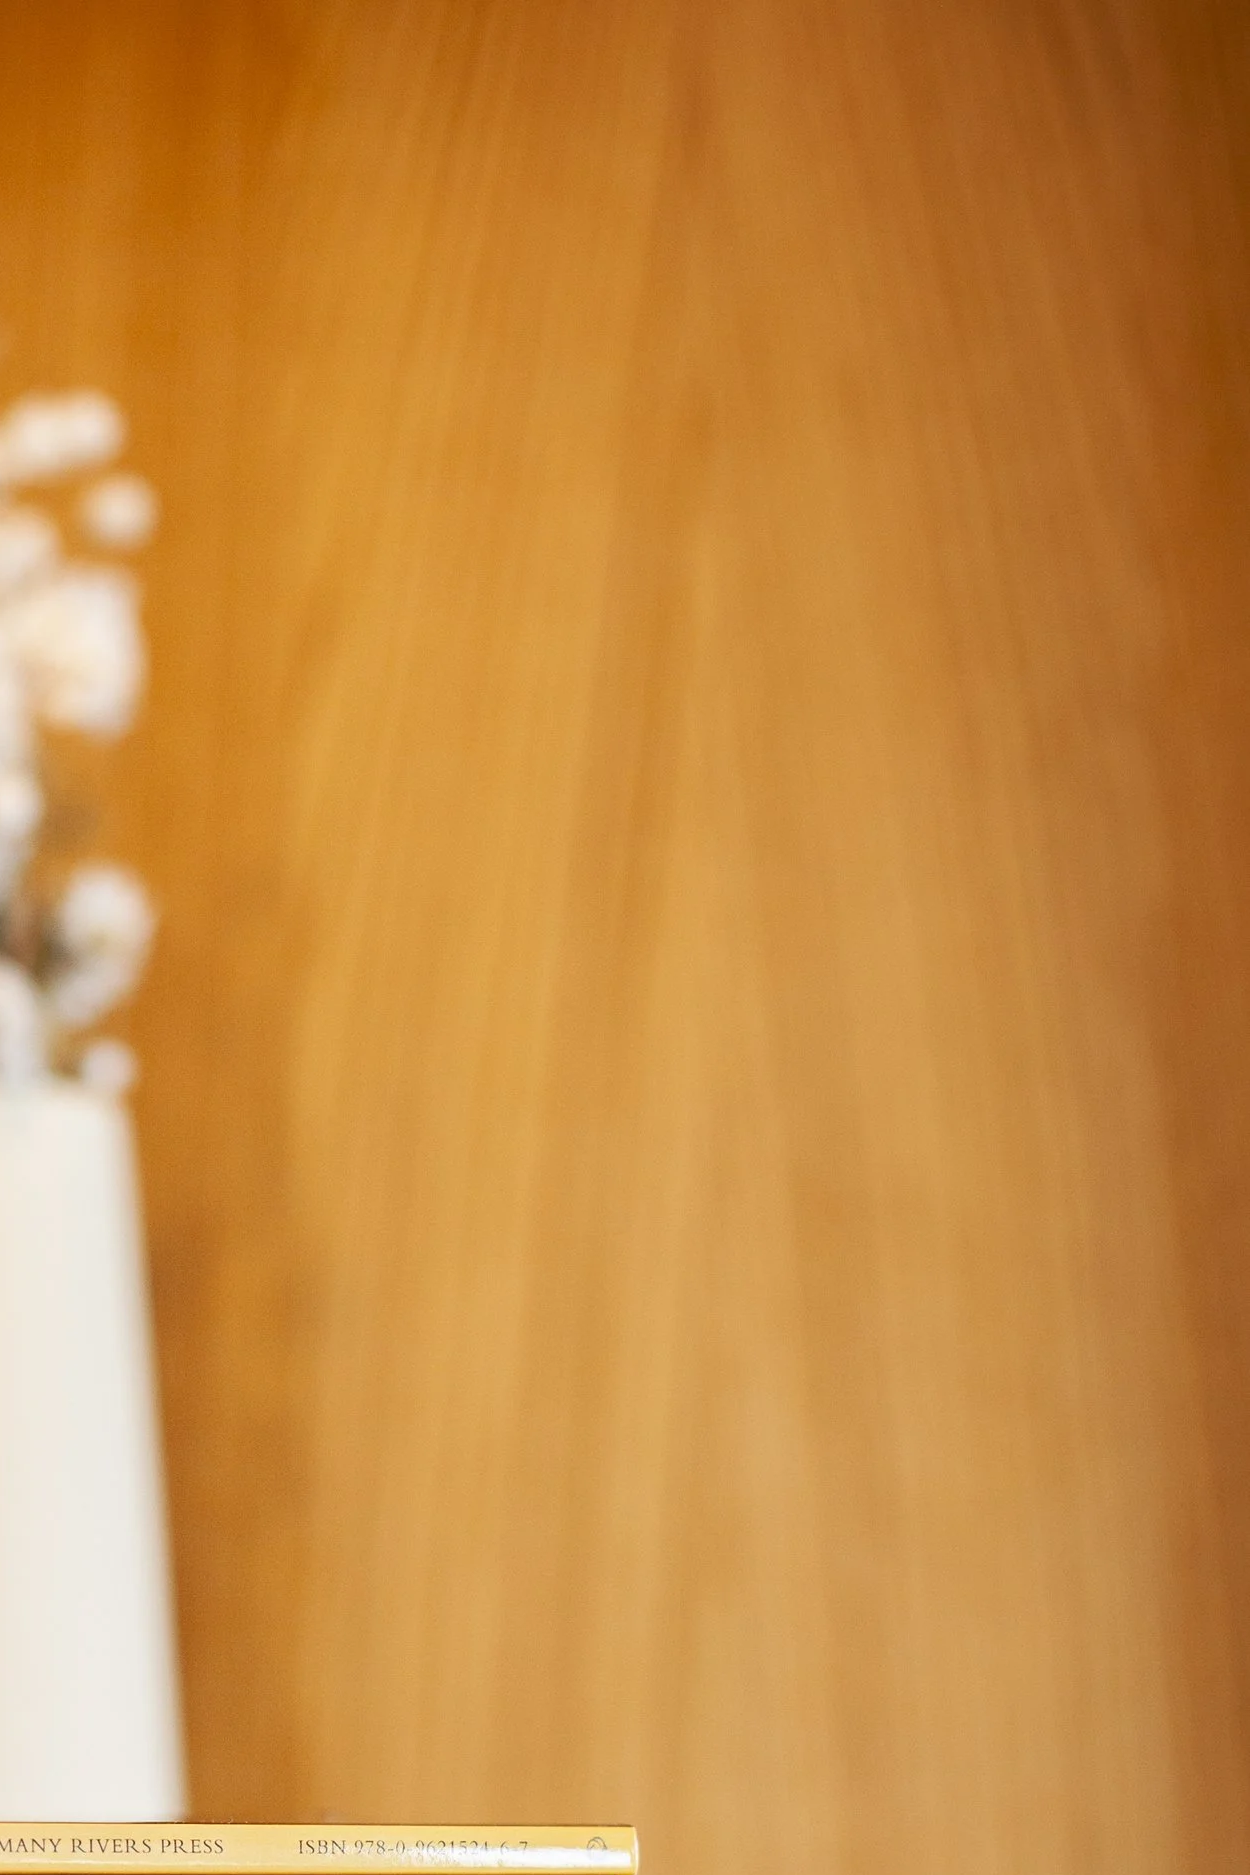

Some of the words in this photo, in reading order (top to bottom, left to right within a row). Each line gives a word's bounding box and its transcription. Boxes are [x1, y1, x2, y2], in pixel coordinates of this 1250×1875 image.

[71, 1838, 152, 1854] RIVERS
[160, 1839, 225, 1854] PRESS
[298, 1839, 346, 1855] ISBN
